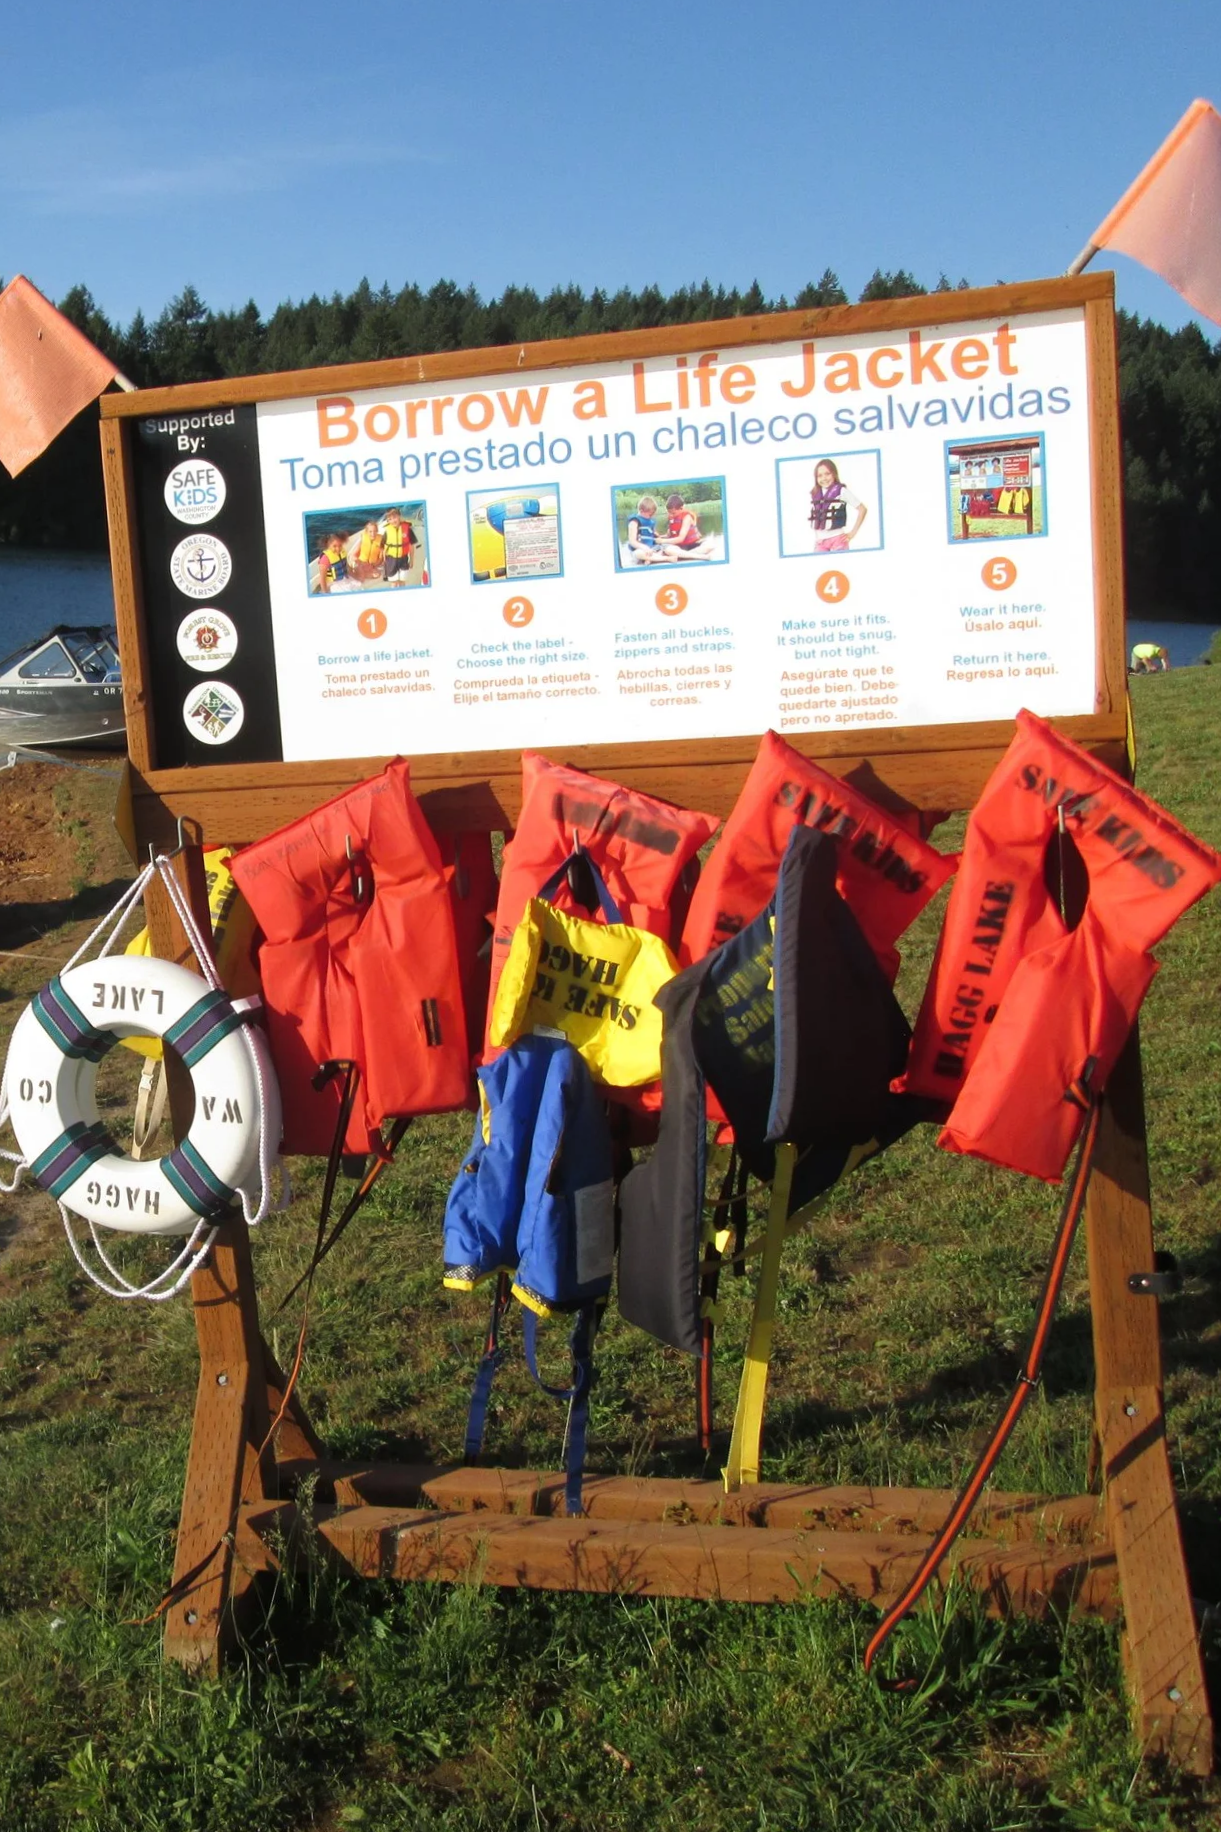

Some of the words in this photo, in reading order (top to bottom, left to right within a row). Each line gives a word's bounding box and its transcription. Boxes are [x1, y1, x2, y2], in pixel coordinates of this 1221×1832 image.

[316, 386, 549, 448] Borrow
[572, 380, 607, 420] a
[633, 352, 756, 415] Life
[781, 323, 1018, 399] Jacket
[146, 409, 234, 435] Supported
[177, 435, 205, 453] By:
[280, 457, 384, 492] Toma
[400, 432, 571, 488] prestado
[589, 431, 636, 460] un
[653, 411, 817, 453] chaleco
[834, 382, 1072, 436] salvavidas
[172, 468, 216, 489] SAFE
[185, 512, 209, 520] COUNTY
[181, 537, 218, 551] OREGON
[172, 556, 184, 587] STATE
[185, 583, 219, 597] MARINE
[218, 552, 229, 587] BOARD
[992, 562, 1008, 585] 5
[823, 576, 840, 597] 4
[665, 589, 679, 610] 3
[511, 602, 526, 623] 2
[959, 606, 995, 617] Wear
[998, 603, 1007, 615] it
[1012, 602, 1047, 614] here.
[366, 613, 377, 634] 1
[782, 620, 816, 631] Make
[820, 618, 850, 628] sure
[853, 615, 862, 626] it
[865, 613, 891, 624] fits.
[614, 632, 657, 643] Fasten
[661, 629, 676, 640] all
[777, 636, 786, 645] It
[789, 632, 835, 645] should
[838, 632, 855, 642] be
[471, 642, 509, 654] Check
[512, 641, 532, 652] the
[535, 637, 565, 650] label
[614, 648, 660, 659] zippers
[664, 643, 688, 655] and
[691, 641, 736, 653] straps.
[794, 650, 816, 660] but
[820, 648, 842, 658] not
[845, 645, 880, 658] tight.
[317, 656, 361, 666] Borrow
[363, 653, 371, 663] a
[373, 650, 392, 662] life
[394, 648, 434, 662] jacket.
[456, 658, 503, 669] Choose
[506, 655, 526, 666] the
[529, 653, 558, 666] right
[560, 651, 590, 662] size.
[953, 654, 999, 666] Return
[1003, 651, 1012, 663] it
[1016, 651, 1052, 663] here.
[324, 674, 357, 684] Toma
[360, 669, 412, 684] prestado
[414, 669, 430, 678] un
[453, 678, 524, 690] Comprueda
[527, 675, 538, 685] la
[541, 671, 591, 685] etiqueta
[616, 667, 671, 680] Abrocha
[674, 664, 711, 676] todas
[714, 663, 733, 674] las
[780, 669, 848, 682] Asegúrate
[852, 666, 877, 678] que
[881, 665, 894, 675] te
[946, 669, 1004, 682] Regresa
[1007, 666, 1021, 677] lo
[104, 687, 116, 695] OR
[321, 687, 367, 698] chaleco
[370, 682, 436, 696] salvavidas.
[453, 693, 480, 706] Elije
[482, 692, 494, 702] el
[496, 687, 542, 701] tamaño
[545, 685, 602, 698] correcto.
[619, 682, 672, 695] hebillas,
[676, 679, 720, 692] cierres
[724, 679, 732, 690] y
[780, 685, 821, 697] quede
[824, 682, 857, 694] bien.
[649, 696, 702, 707] correas.
[778, 701, 837, 713] quedarte
[840, 695, 898, 710] ajustado
[780, 717, 811, 728] pero
[814, 715, 831, 724] no
[834, 711, 898, 725] apretado.
[1096, 814, 1186, 890] KIDS
[935, 982, 986, 1079] HAGG
[965, 879, 1015, 976] LAKE
[92, 982, 164, 1016] LAKE
[19, 1077, 53, 1105] CO
[200, 1095, 244, 1125] WA
[86, 1180, 161, 1216] HAGG
